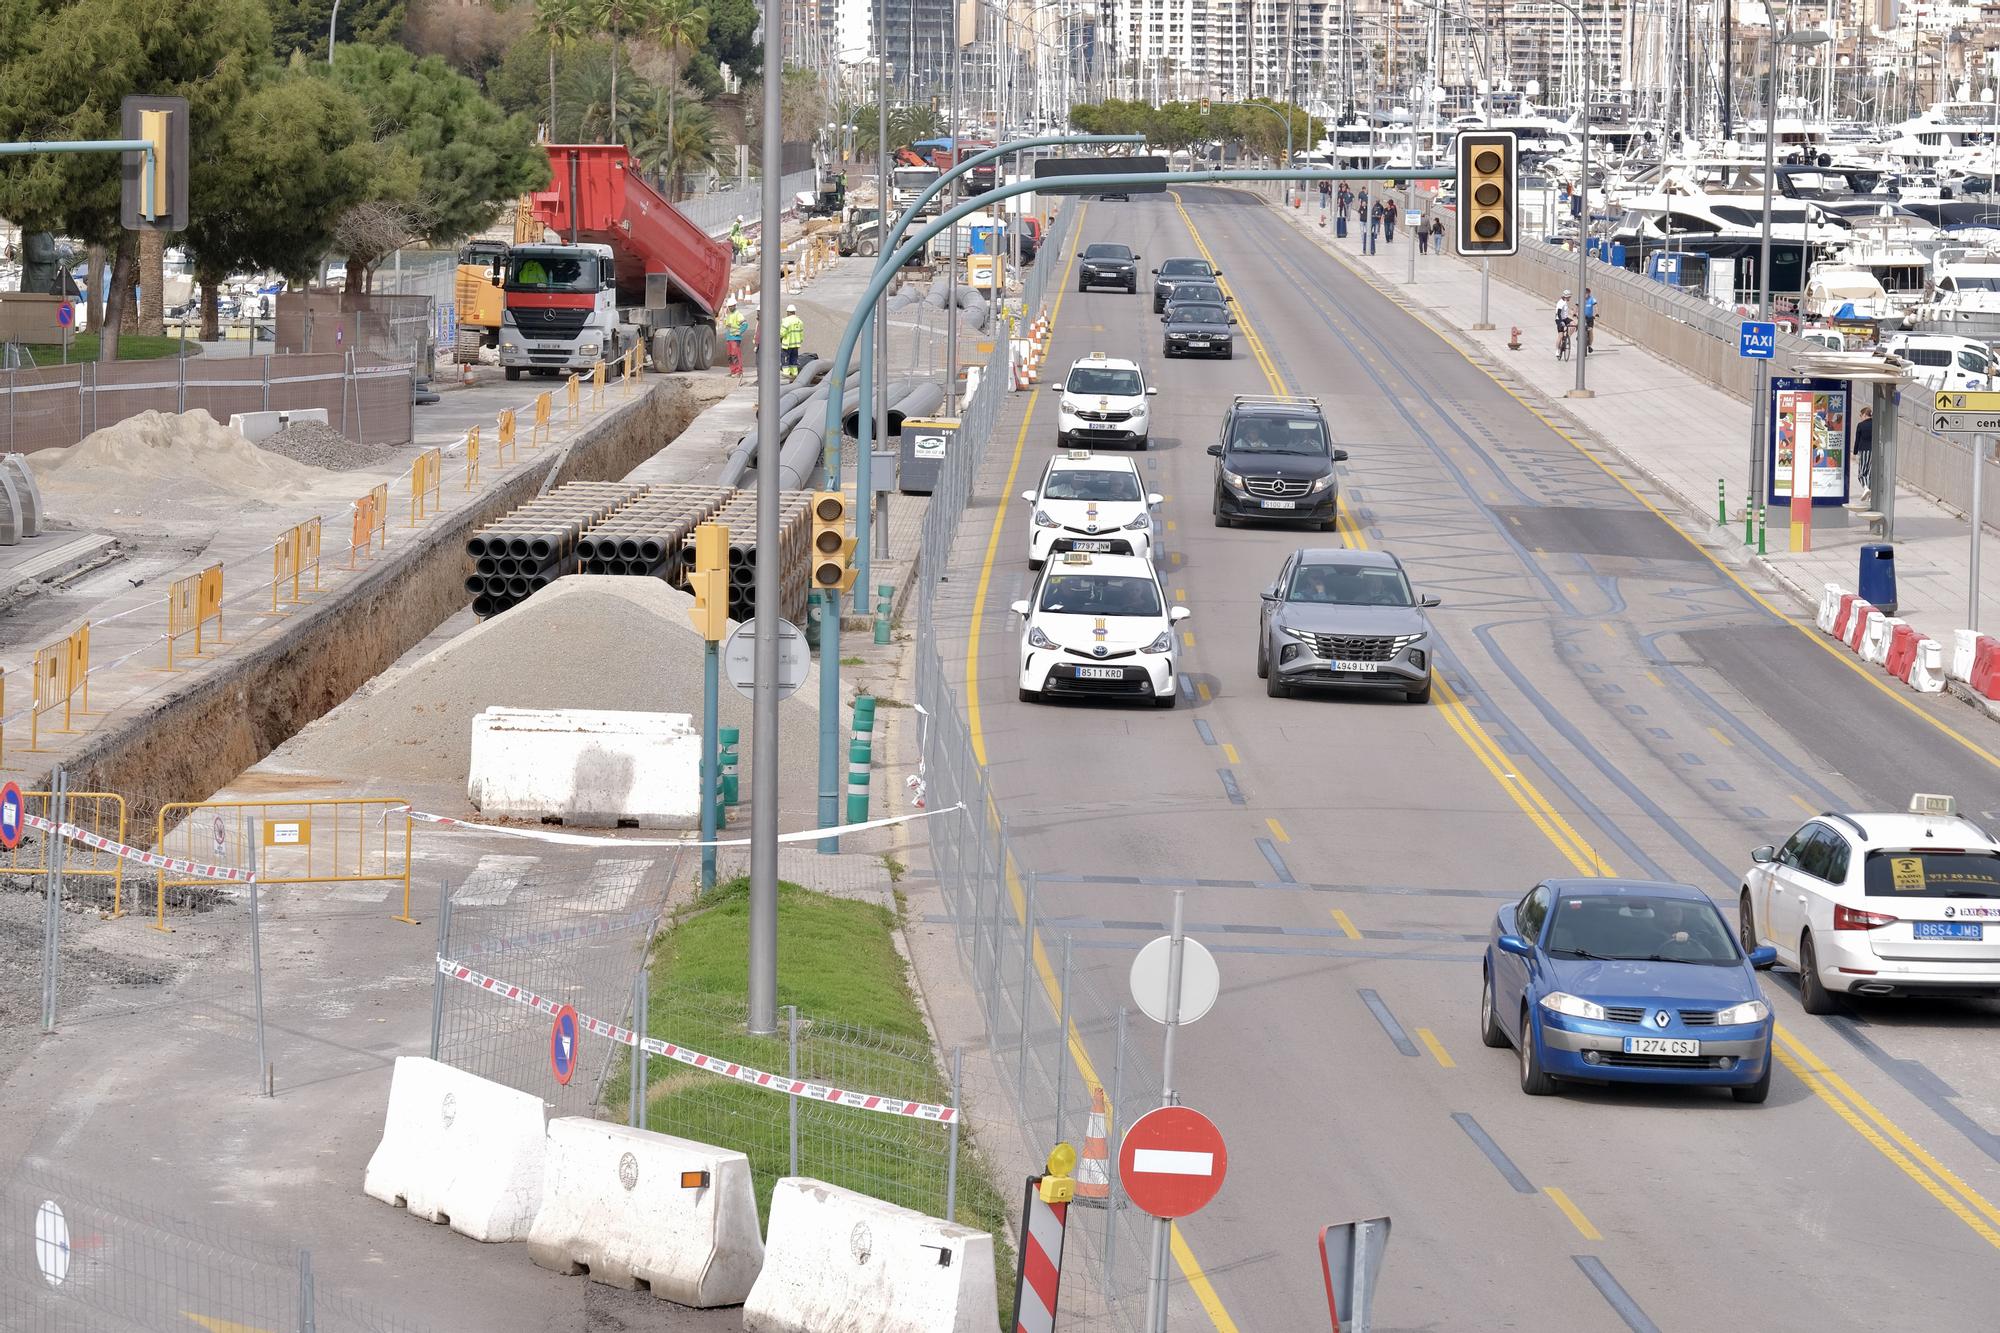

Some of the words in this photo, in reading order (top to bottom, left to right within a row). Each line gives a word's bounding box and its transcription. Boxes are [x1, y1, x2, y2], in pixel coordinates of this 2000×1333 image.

[1743, 334, 1773, 347] TAXI
[1337, 662, 1357, 670] 4949
[1360, 663, 1375, 671] LYX
[1082, 668, 1102, 676] 8511
[1106, 670, 1122, 678] KRD
[1922, 924, 1953, 936] 8654
[1957, 925, 1979, 936] JMB
[1635, 1040, 1666, 1052] 1274
[1671, 1041, 1696, 1054] CSJ
